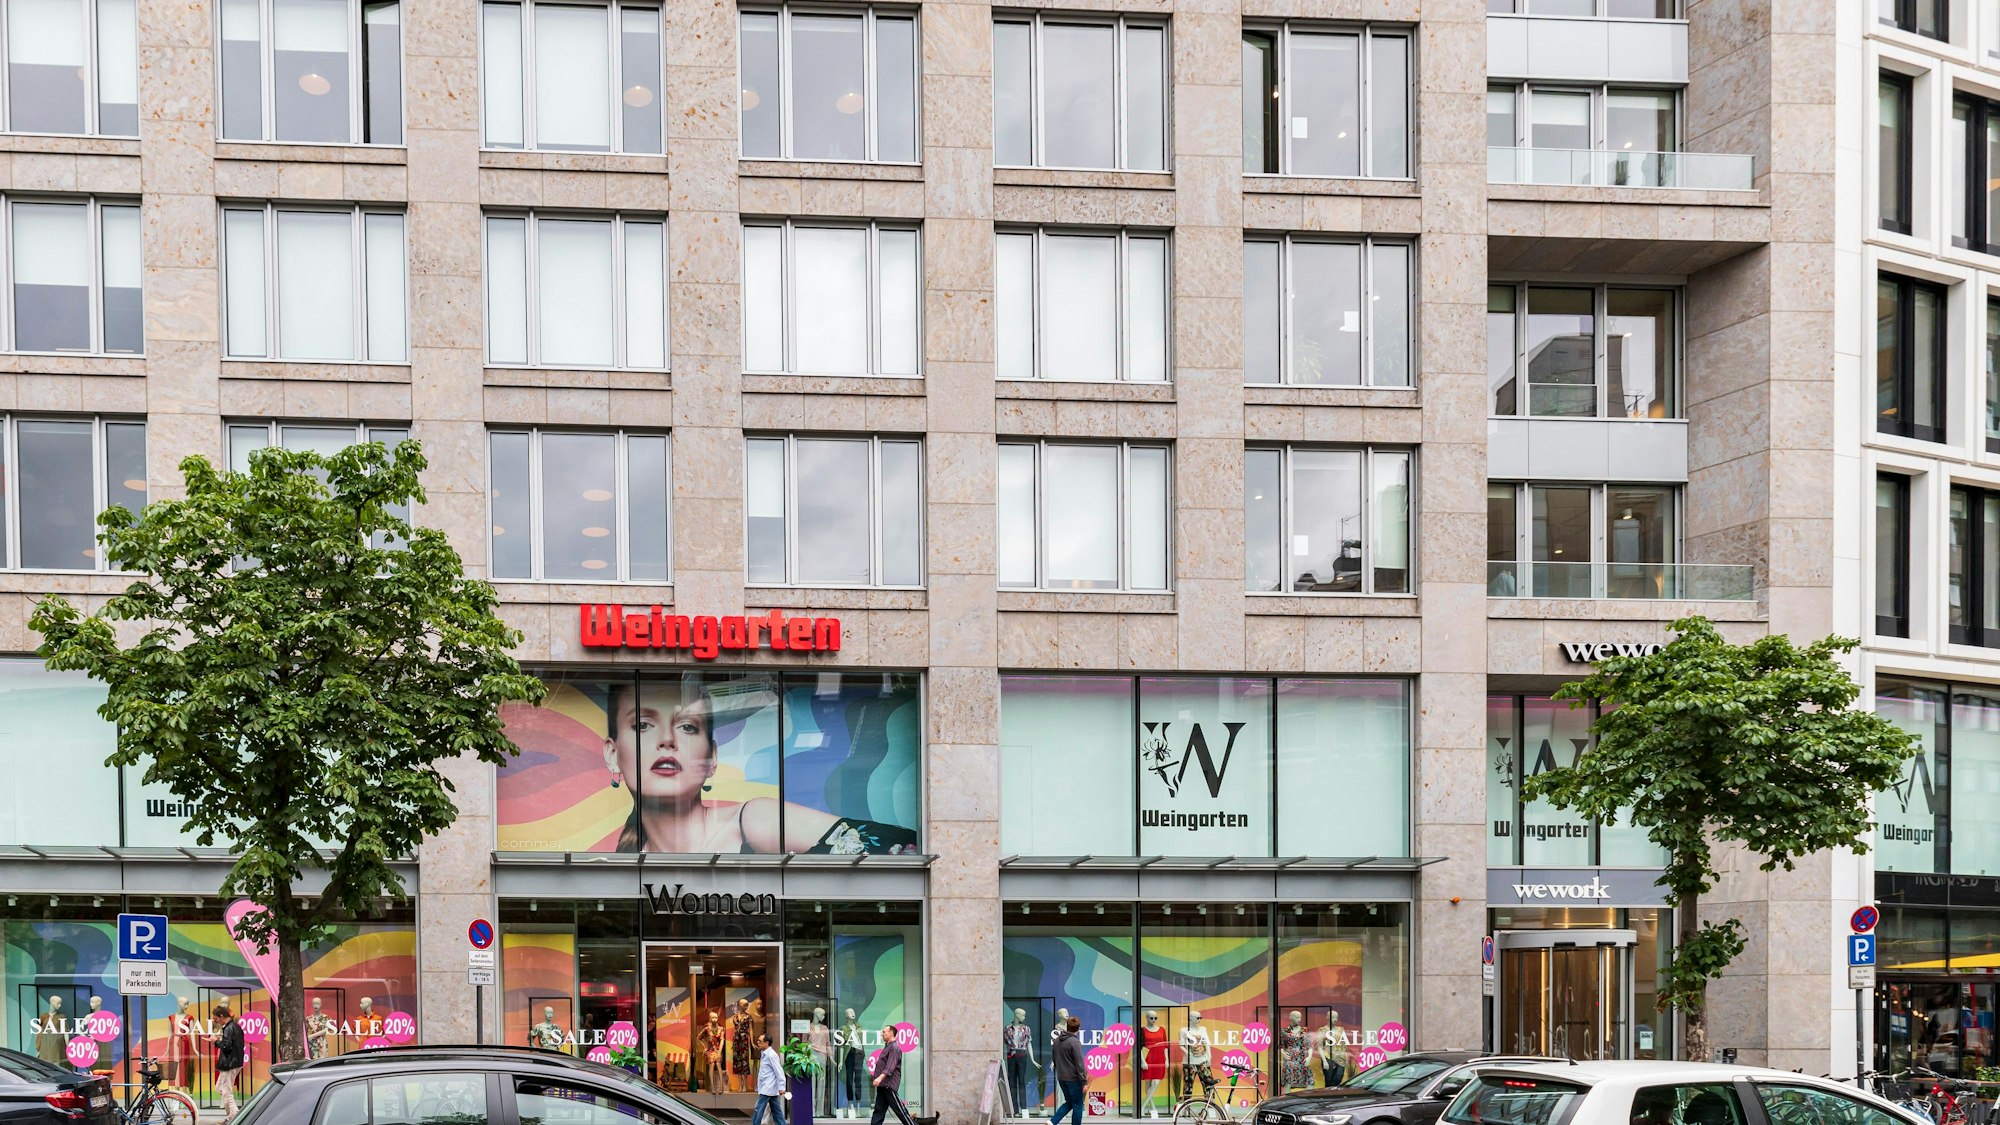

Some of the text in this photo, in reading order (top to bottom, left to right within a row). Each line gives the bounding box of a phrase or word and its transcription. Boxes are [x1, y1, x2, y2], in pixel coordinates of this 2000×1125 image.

[580, 604, 841, 659] Weingarten
[1142, 810, 1248, 831] Weingarten
[1883, 824, 1933, 845] Weingar
[1512, 876, 1611, 899] wework
[643, 884, 778, 915] Women
[130, 921, 156, 954] P
[1855, 939, 1869, 961] P
[125, 980, 162, 988] Parkschein
[30, 1018, 119, 1035] SALE 20%
[178, 1019, 220, 1035] SAL
[327, 1018, 415, 1036] SALE 20%
[551, 1029, 636, 1045] SALE 20%
[1051, 1030, 1134, 1045] SLE 20%
[1187, 1028, 1271, 1046] SALE 20%
[1325, 1029, 1405, 1046] SALE 20%
[68, 1042, 98, 1059] 30%
[1087, 1055, 1113, 1070] 30%
